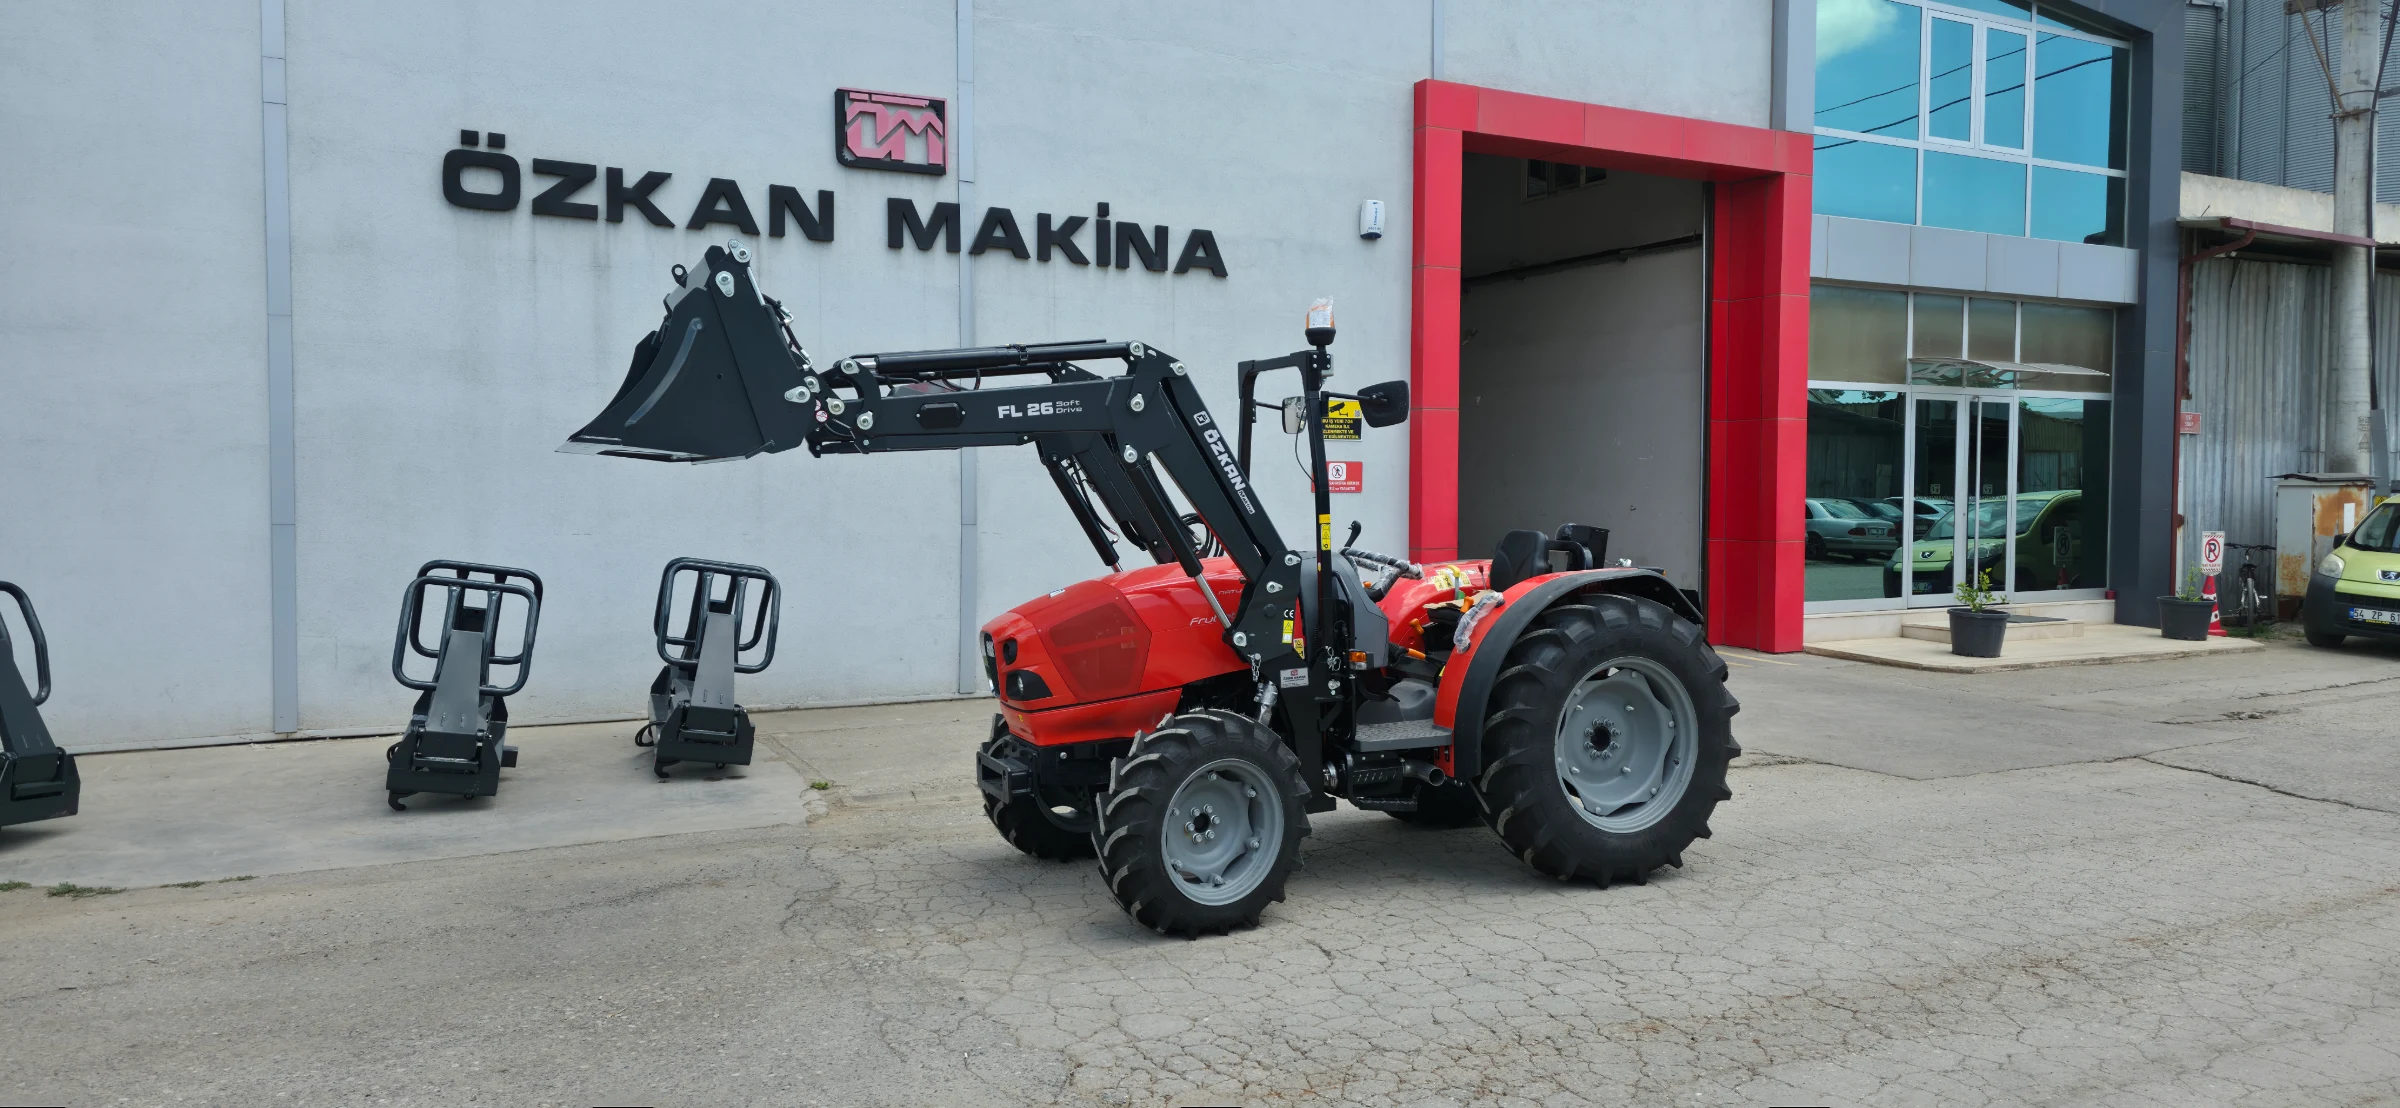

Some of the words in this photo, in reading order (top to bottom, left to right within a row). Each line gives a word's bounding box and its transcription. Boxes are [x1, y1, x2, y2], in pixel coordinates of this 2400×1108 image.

[441, 130, 835, 244] ÖZKAN
[887, 198, 1229, 279] MAKİNA
[1055, 399, 1080, 407] Soft
[997, 405, 1023, 419] FL
[1027, 402, 1054, 416] 26
[1055, 406, 1083, 414] Drive
[1203, 429, 1246, 491] ÖZKAN
[1284, 609, 1295, 619] CE
[2353, 609, 2364, 618] 54
[2371, 610, 2383, 620] ZP
